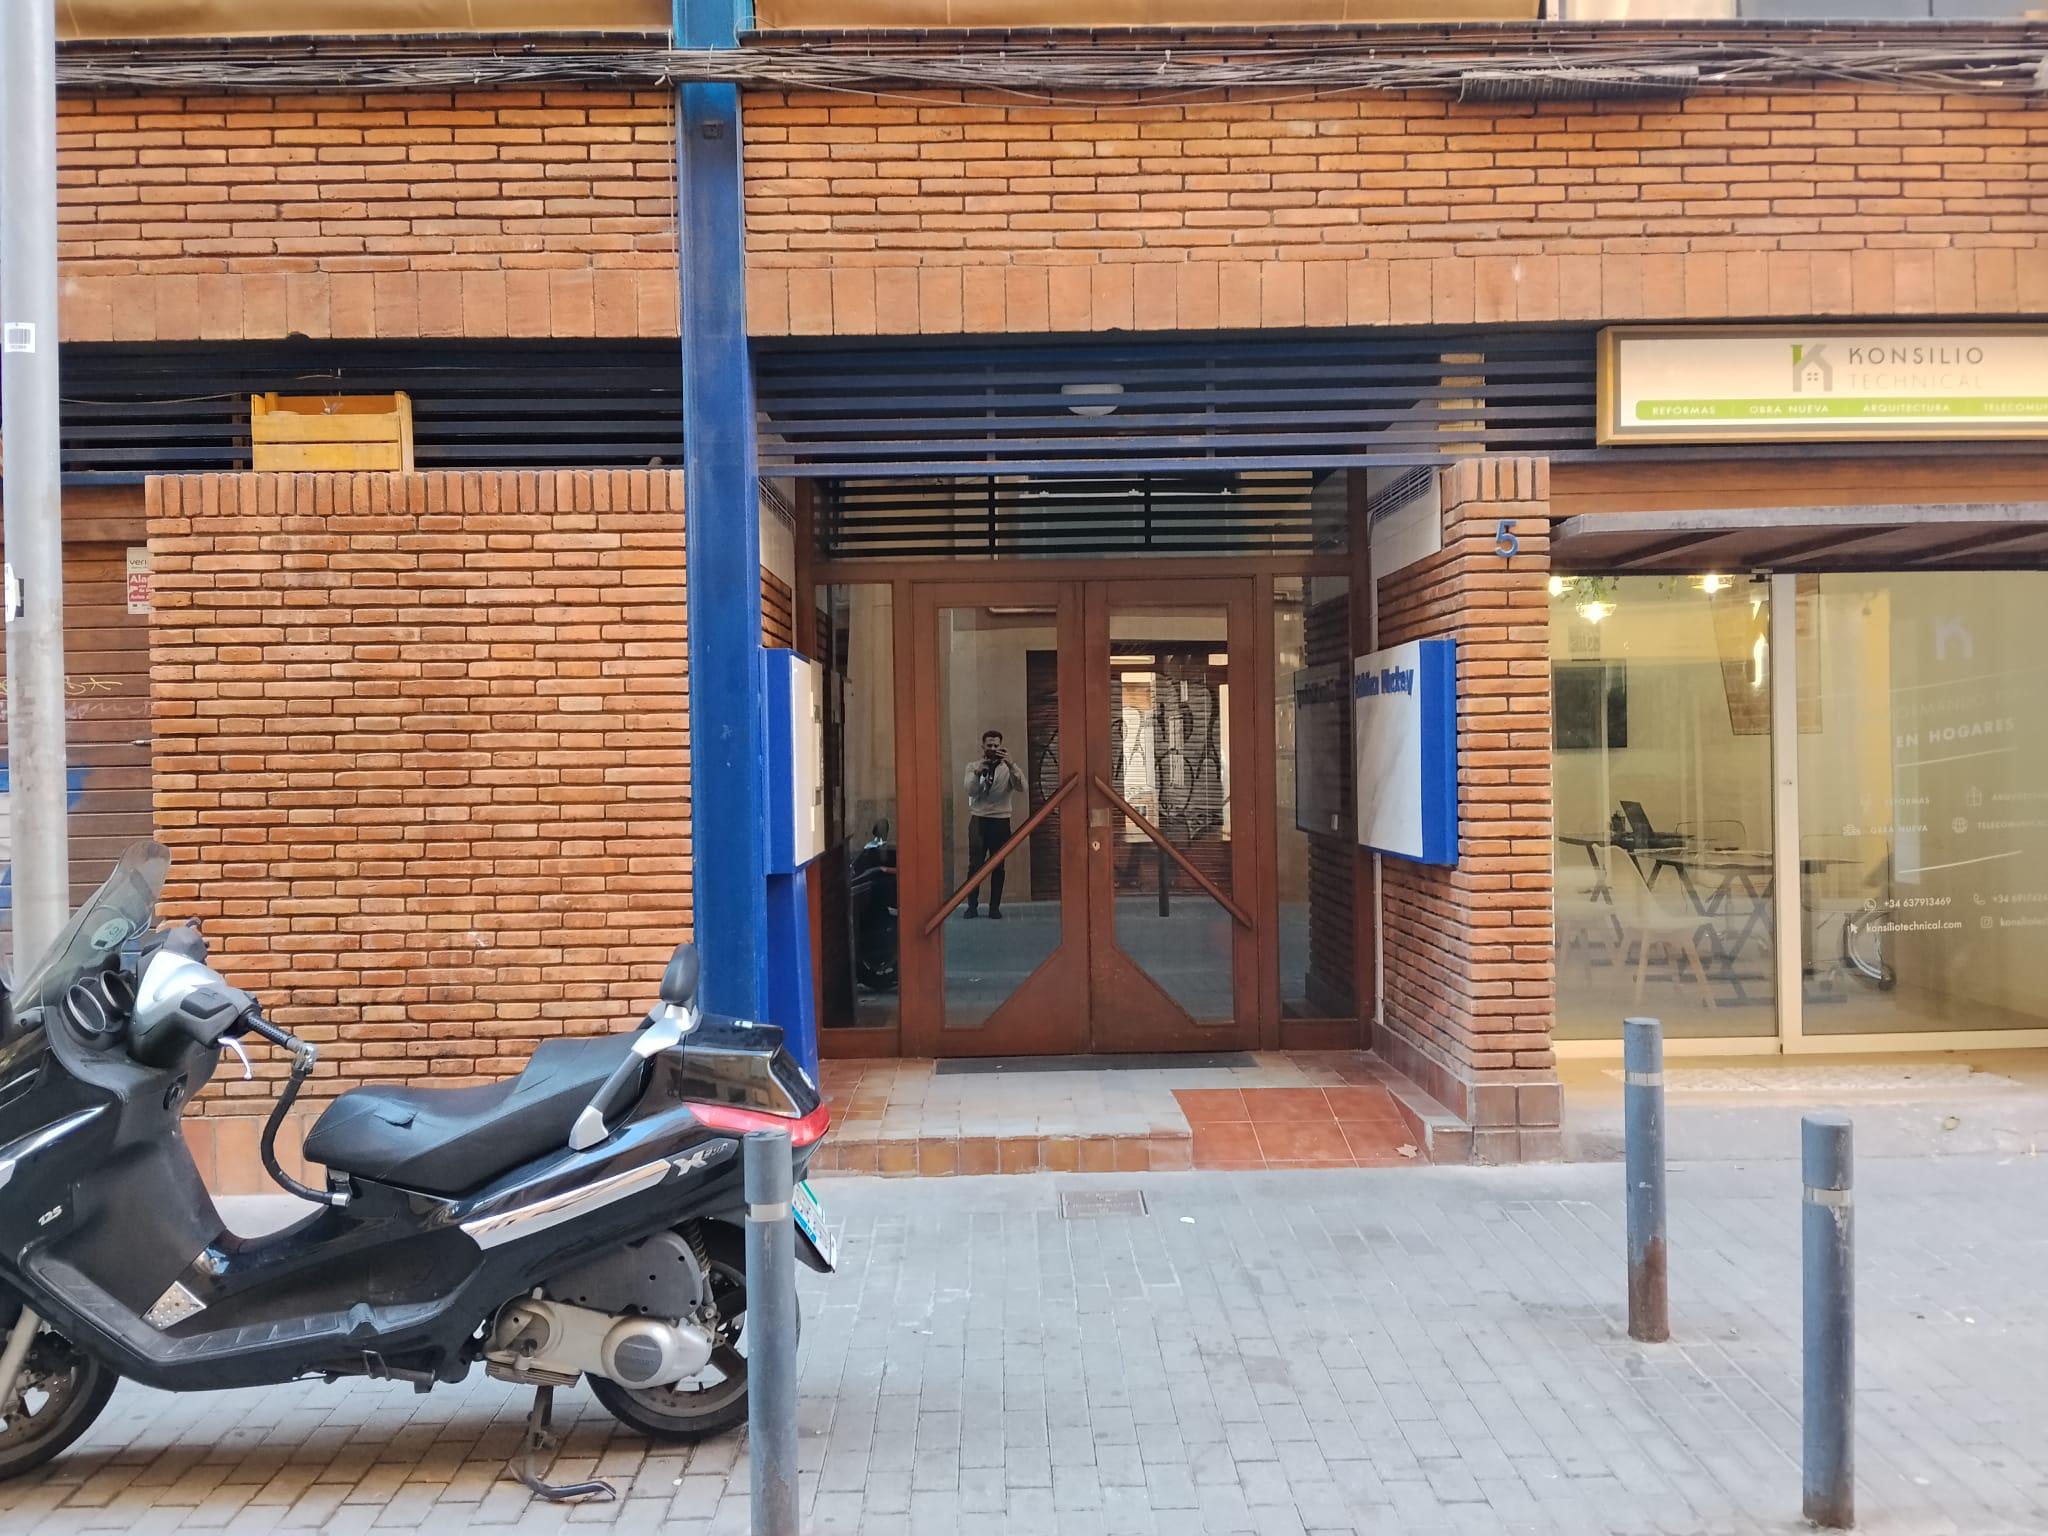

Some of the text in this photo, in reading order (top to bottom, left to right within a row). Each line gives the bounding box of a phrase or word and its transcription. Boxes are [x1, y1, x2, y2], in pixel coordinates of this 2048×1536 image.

[1849, 347, 1984, 365] KONSILIO
[1849, 373, 1984, 390] TECHNICAL
[1652, 405, 1716, 416] REFORMAS
[1750, 404, 1829, 415] OBRA NUEVA
[1863, 403, 1951, 413] ARQUITECTURA
[1495, 519, 1520, 559] 5
[1895, 717, 2015, 749] EN HOGARES
[1866, 919, 1963, 933] konsiliotechnical.com
[38, 1204, 63, 1226] 125
